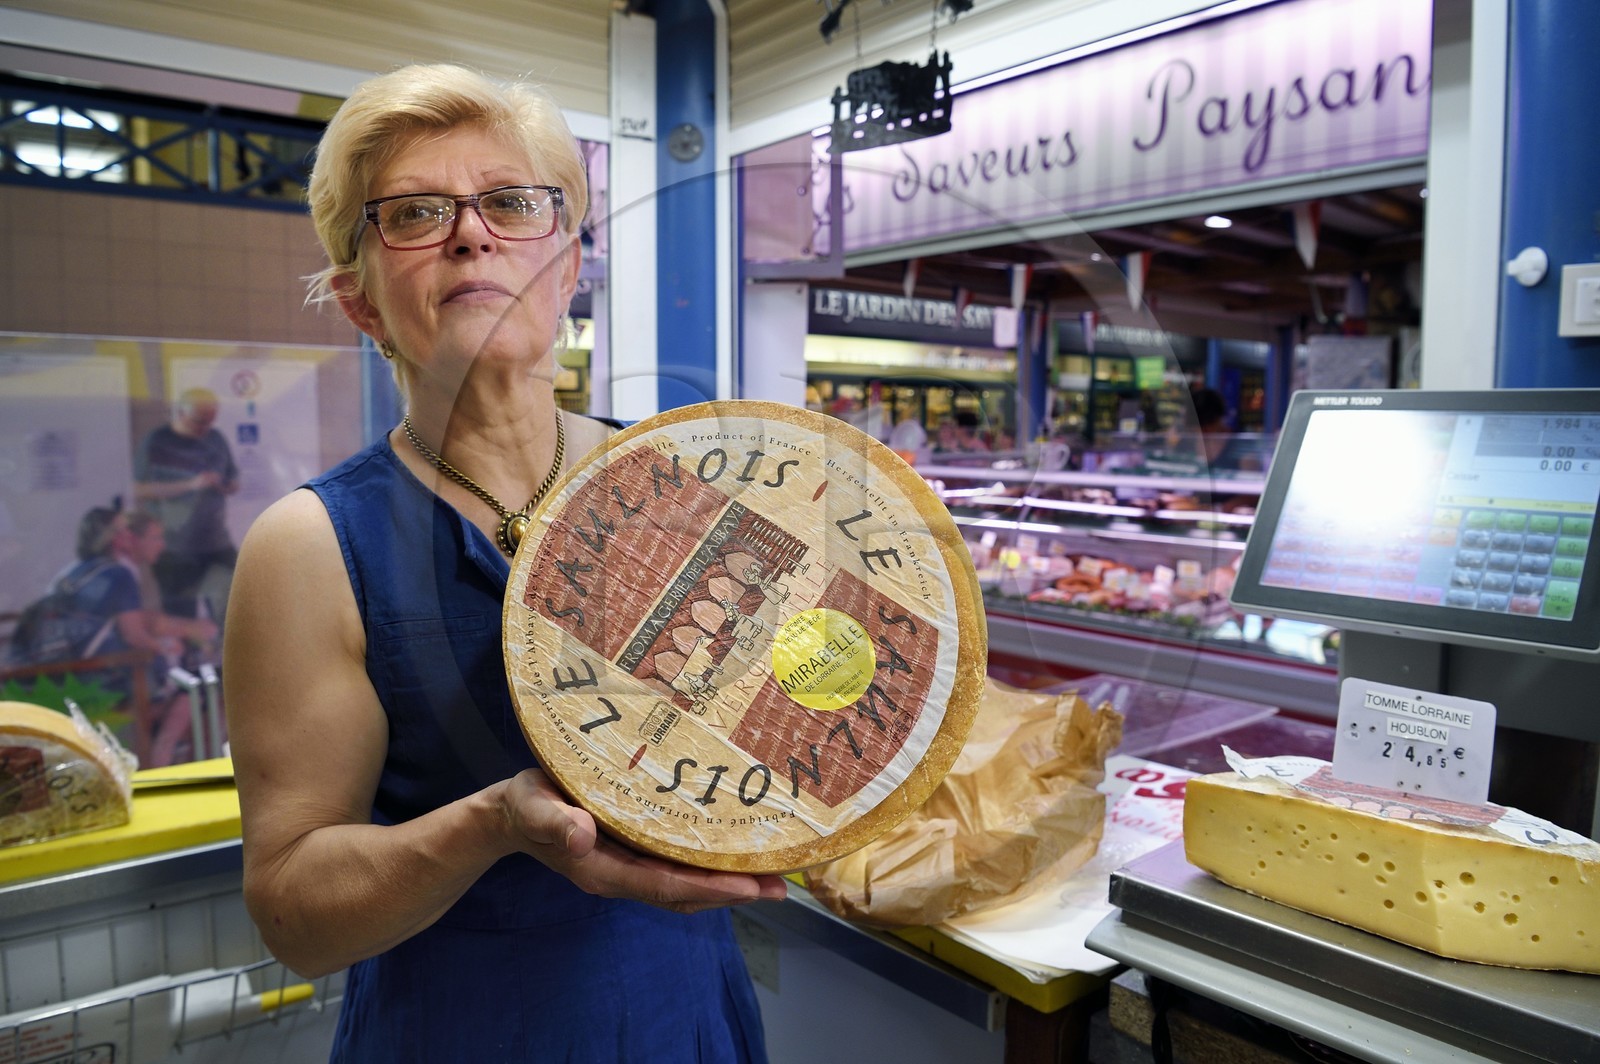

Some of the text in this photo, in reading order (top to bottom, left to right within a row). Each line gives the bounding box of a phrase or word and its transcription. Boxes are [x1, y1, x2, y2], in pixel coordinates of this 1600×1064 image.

[892, 54, 1431, 202] Saveurs Paysan
[815, 289, 843, 316] LE
[844, 291, 920, 323] JARDIN
[1349, 396, 1383, 406] TOLEDO
[691, 431, 744, 443] Product
[750, 434, 764, 442] of
[769, 437, 811, 457] France
[1543, 445, 1576, 459] 0.00
[1540, 459, 1572, 472] 0.00
[826, 459, 888, 512] Hergestellt
[888, 513, 898, 527] in
[835, 509, 903, 577] LE
[899, 530, 931, 600] Frankreich
[620, 578, 688, 670] FROMAGERIE
[684, 564, 701, 580] DE
[695, 502, 745, 565] L'ABBAYE
[779, 622, 863, 694] MIRABELLE
[804, 681, 815, 692] DE
[812, 659, 842, 685] LORRAINE
[553, 658, 622, 734] LE
[1366, 693, 1472, 726] TOMME LORRAINE
[540, 692, 590, 765] Fromagerie
[650, 710, 677, 744] LORRAIN
[1391, 722, 1448, 741] HOUBLON
[1454, 747, 1466, 760] €
[608, 779, 635, 797] par
[636, 795, 698, 825] Lorraine
[730, 810, 796, 828] Fabriqué
